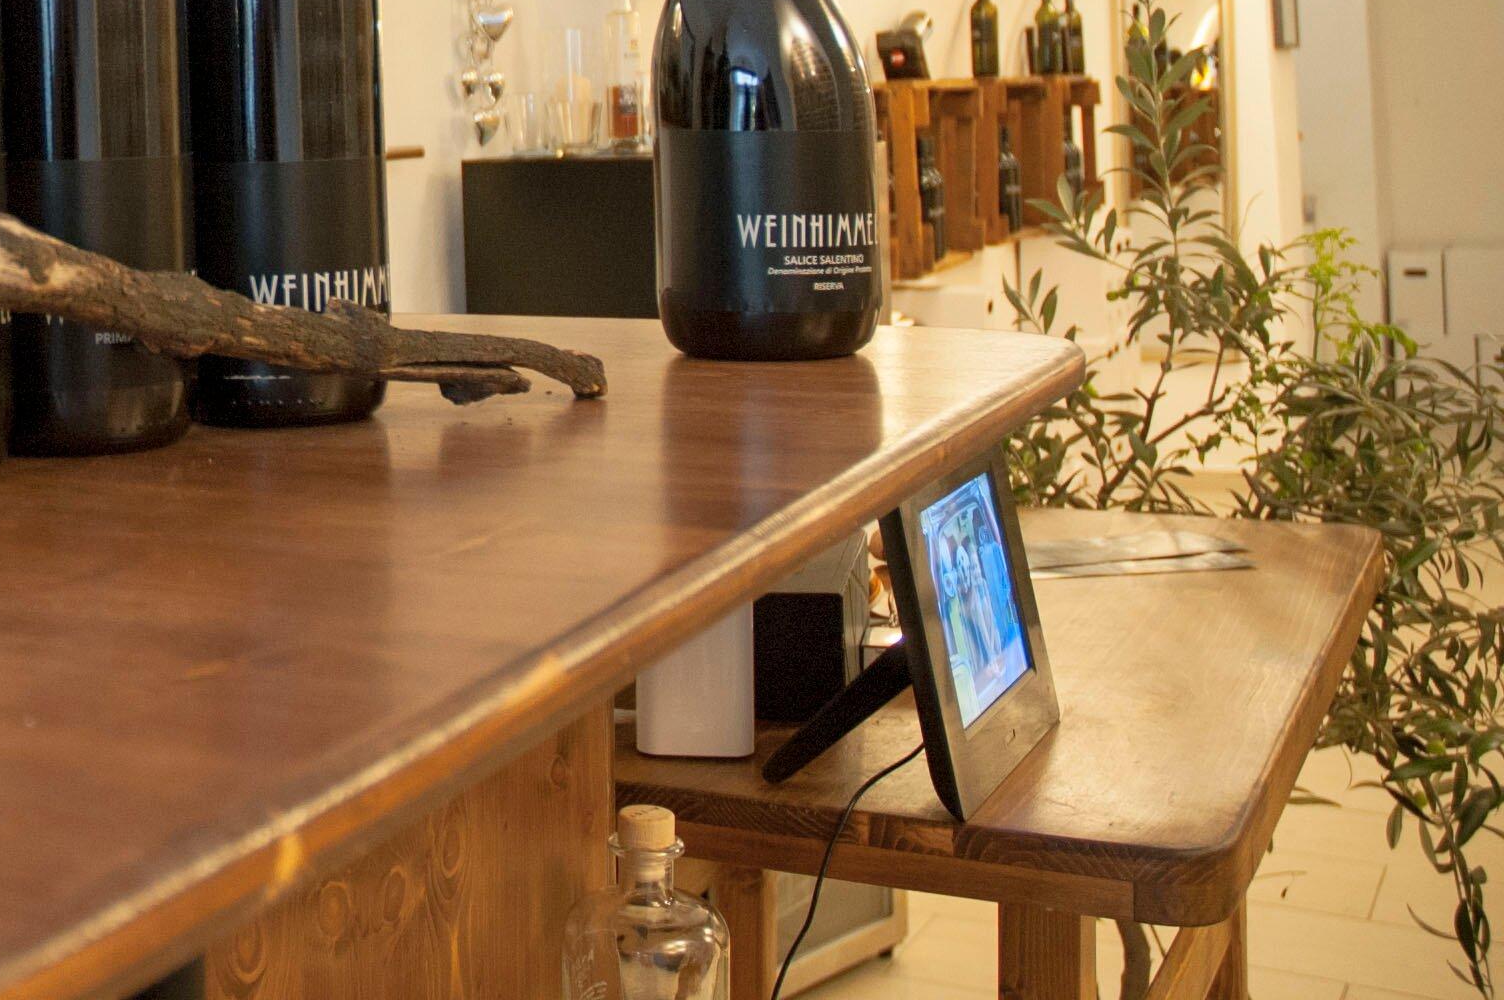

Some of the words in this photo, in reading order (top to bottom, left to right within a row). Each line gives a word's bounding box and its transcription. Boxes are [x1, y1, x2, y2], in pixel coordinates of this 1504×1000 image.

[784, 255, 818, 266] SALICE
[819, 254, 864, 265] SALENTINO
[813, 281, 844, 291] RISERVA
